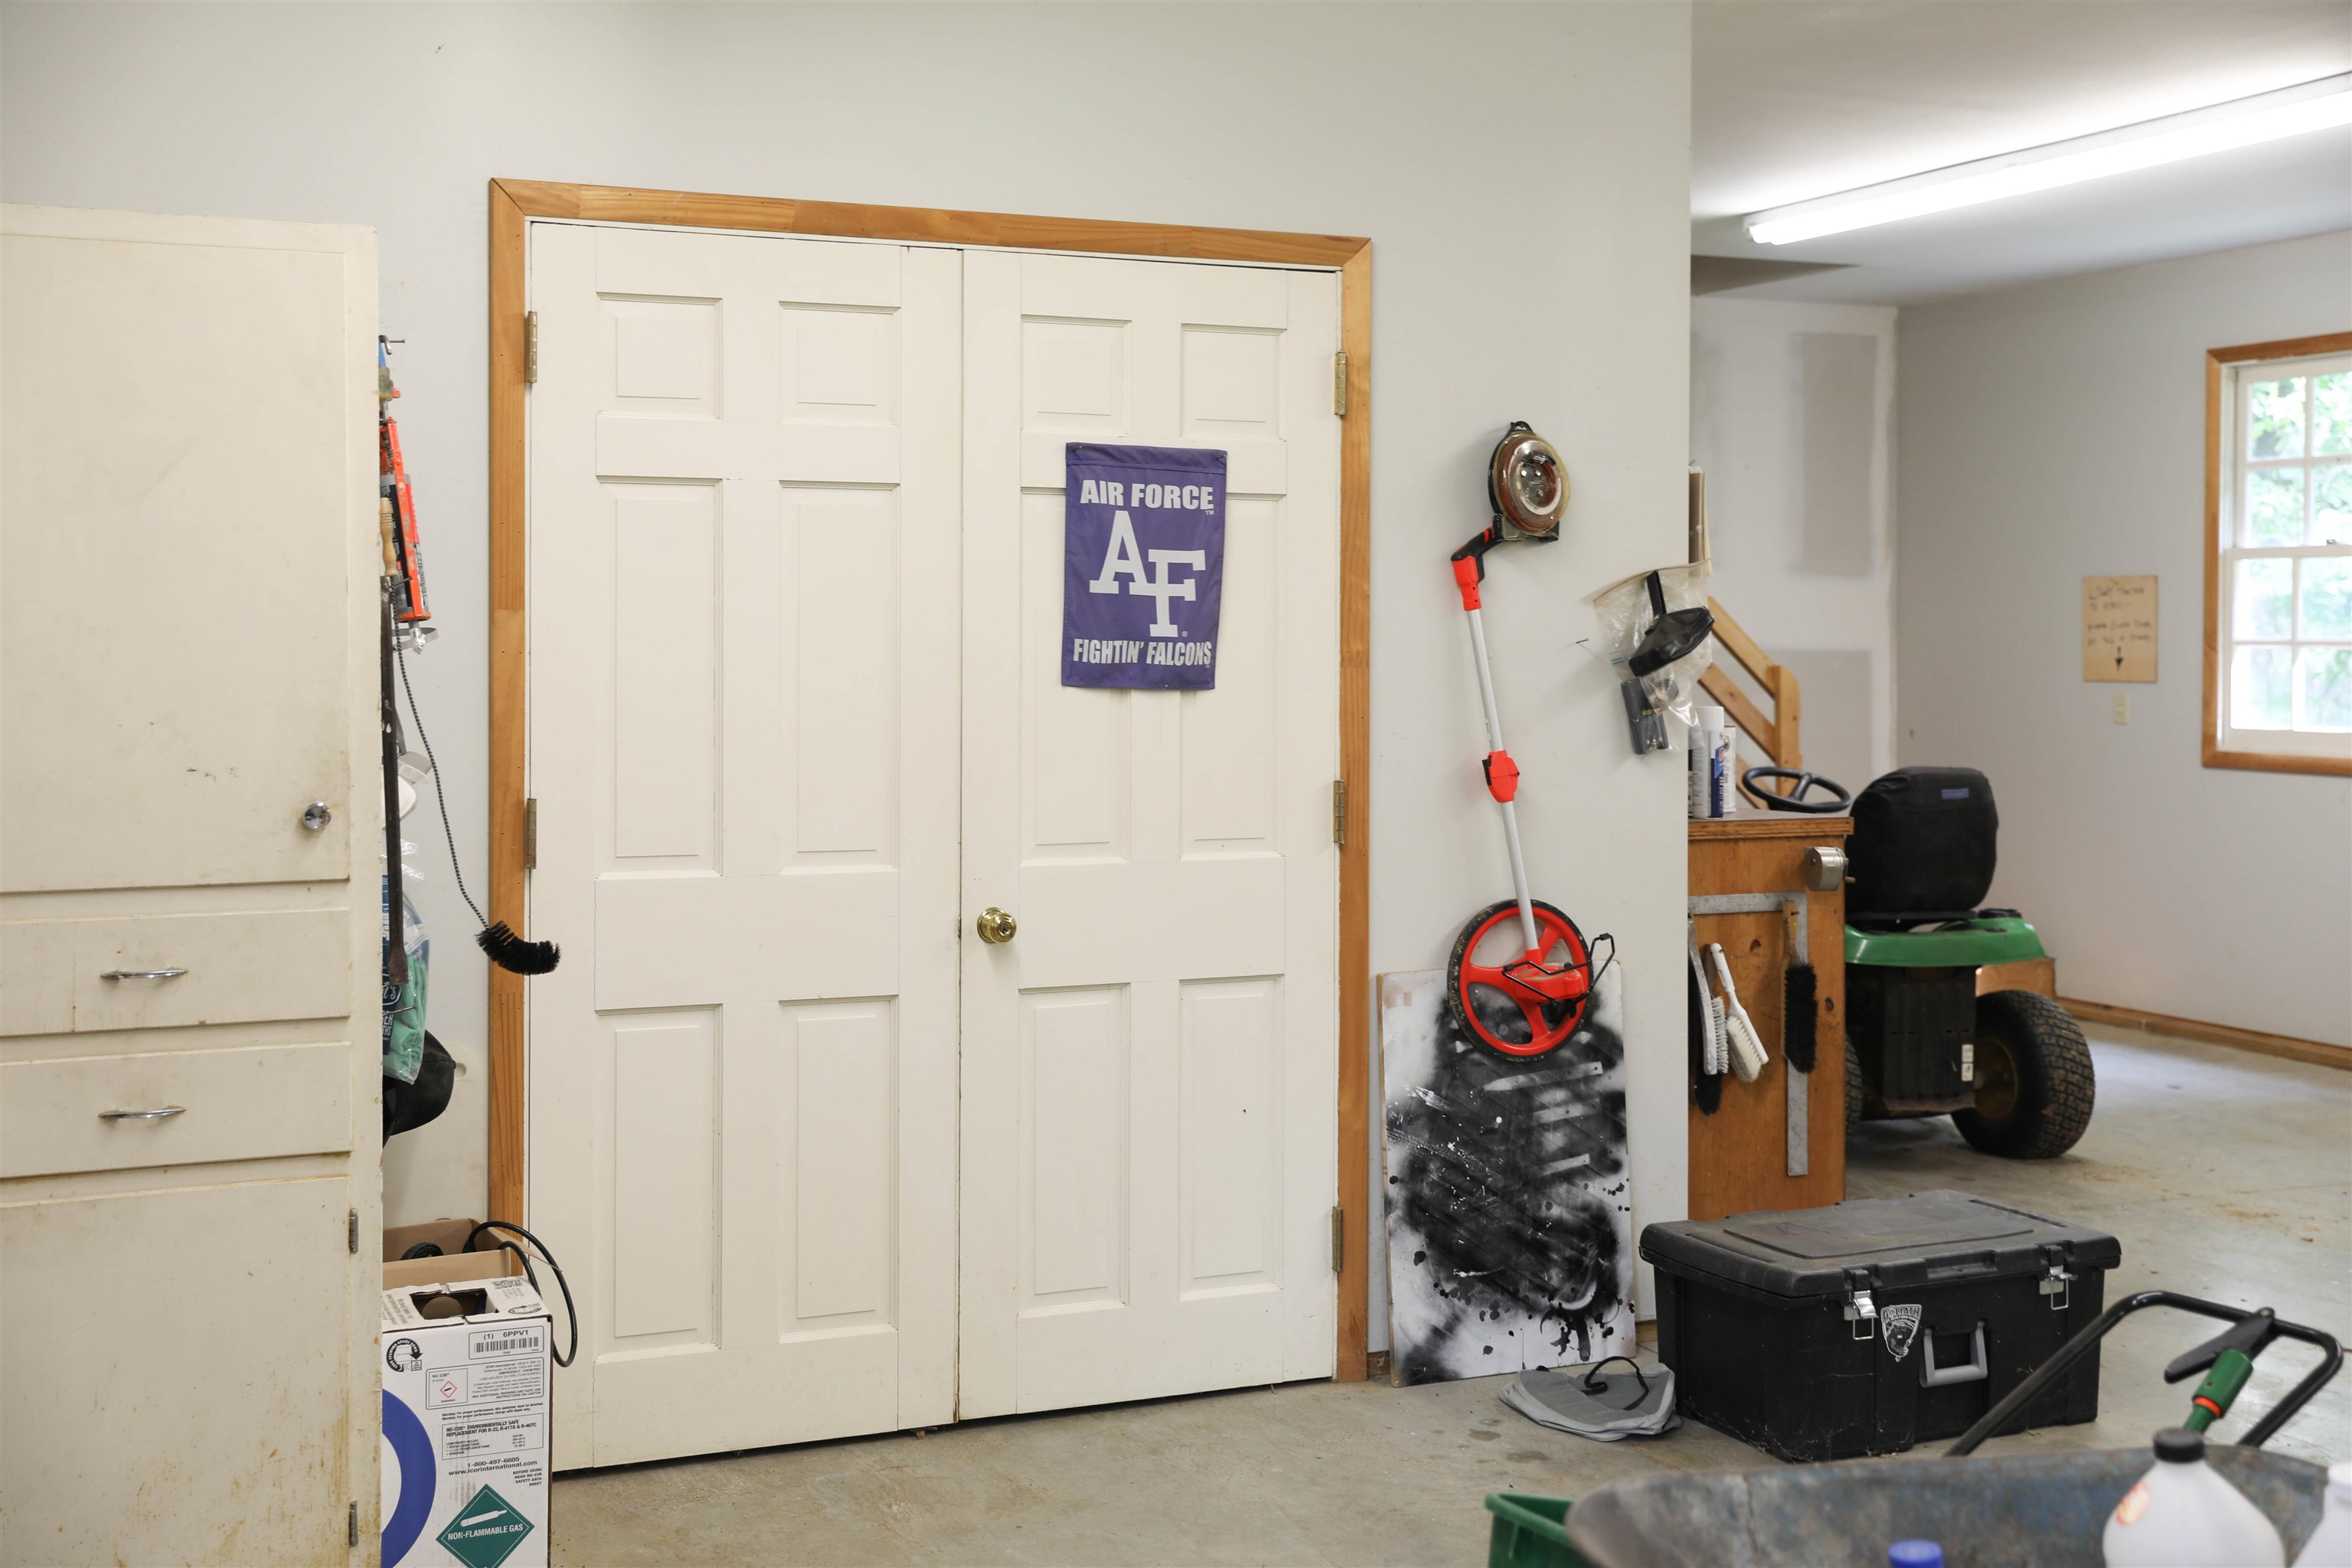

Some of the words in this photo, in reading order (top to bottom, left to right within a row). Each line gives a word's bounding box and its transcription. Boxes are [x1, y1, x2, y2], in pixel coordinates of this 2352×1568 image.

[1080, 480, 1124, 506] AIR
[1131, 483, 1214, 510] FORCE
[1073, 639, 1144, 663] FIGHTIN'
[1145, 642, 1212, 666] FALCONS
[1883, 1306, 1920, 1318] GOLIATH
[467, 1421, 508, 1429] ENVIRONMENTALLY
[449, 1461, 537, 1475] www.icorinternational.com
[467, 1457, 519, 1467] 1-800-497-6805
[448, 1526, 508, 1540] NON-FLAMMABLE
